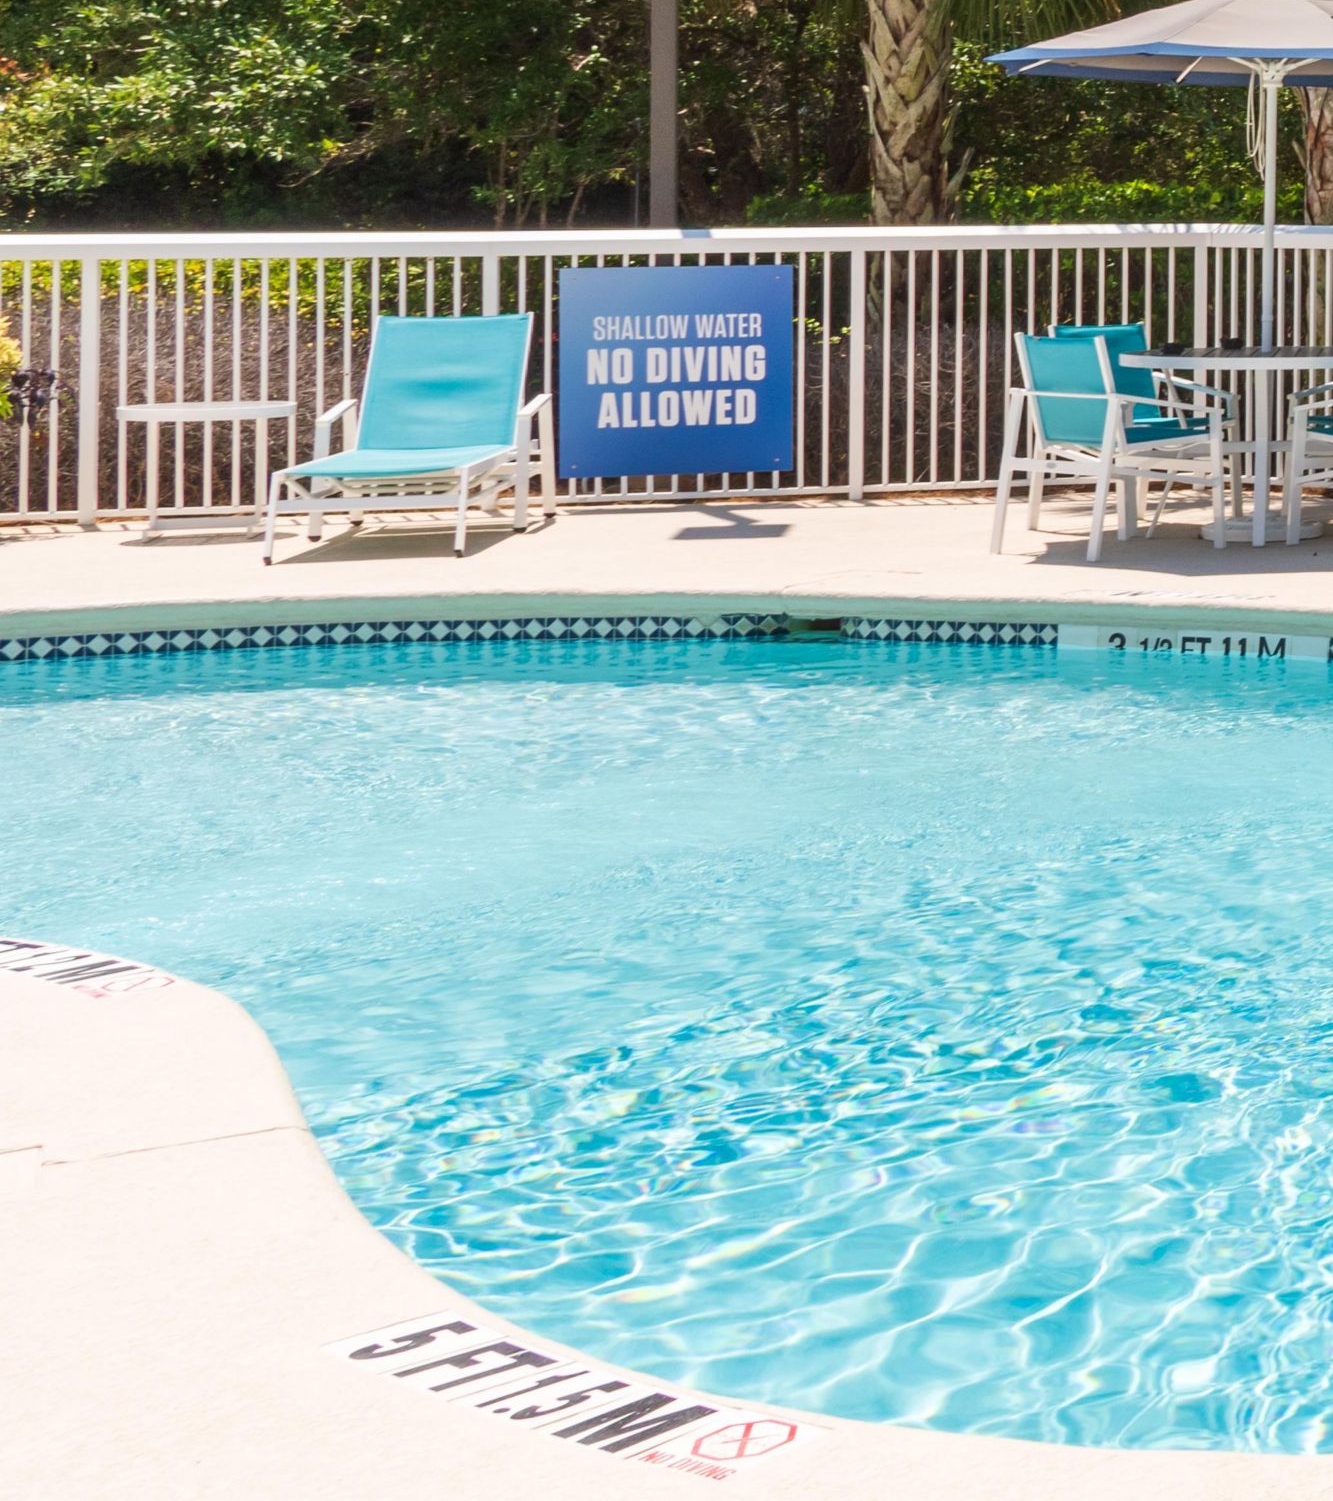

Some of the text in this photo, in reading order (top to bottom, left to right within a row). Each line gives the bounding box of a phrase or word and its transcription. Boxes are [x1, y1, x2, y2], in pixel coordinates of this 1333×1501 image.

[593, 313, 762, 341] SHALLOW WATER
[587, 345, 767, 385] NO DIVING
[597, 388, 757, 428] ALLOWED
[1258, 636, 1287, 658] M
[348, 1320, 718, 1453] 5 FT 1.5 M
[667, 1458, 737, 1480] DIVING
